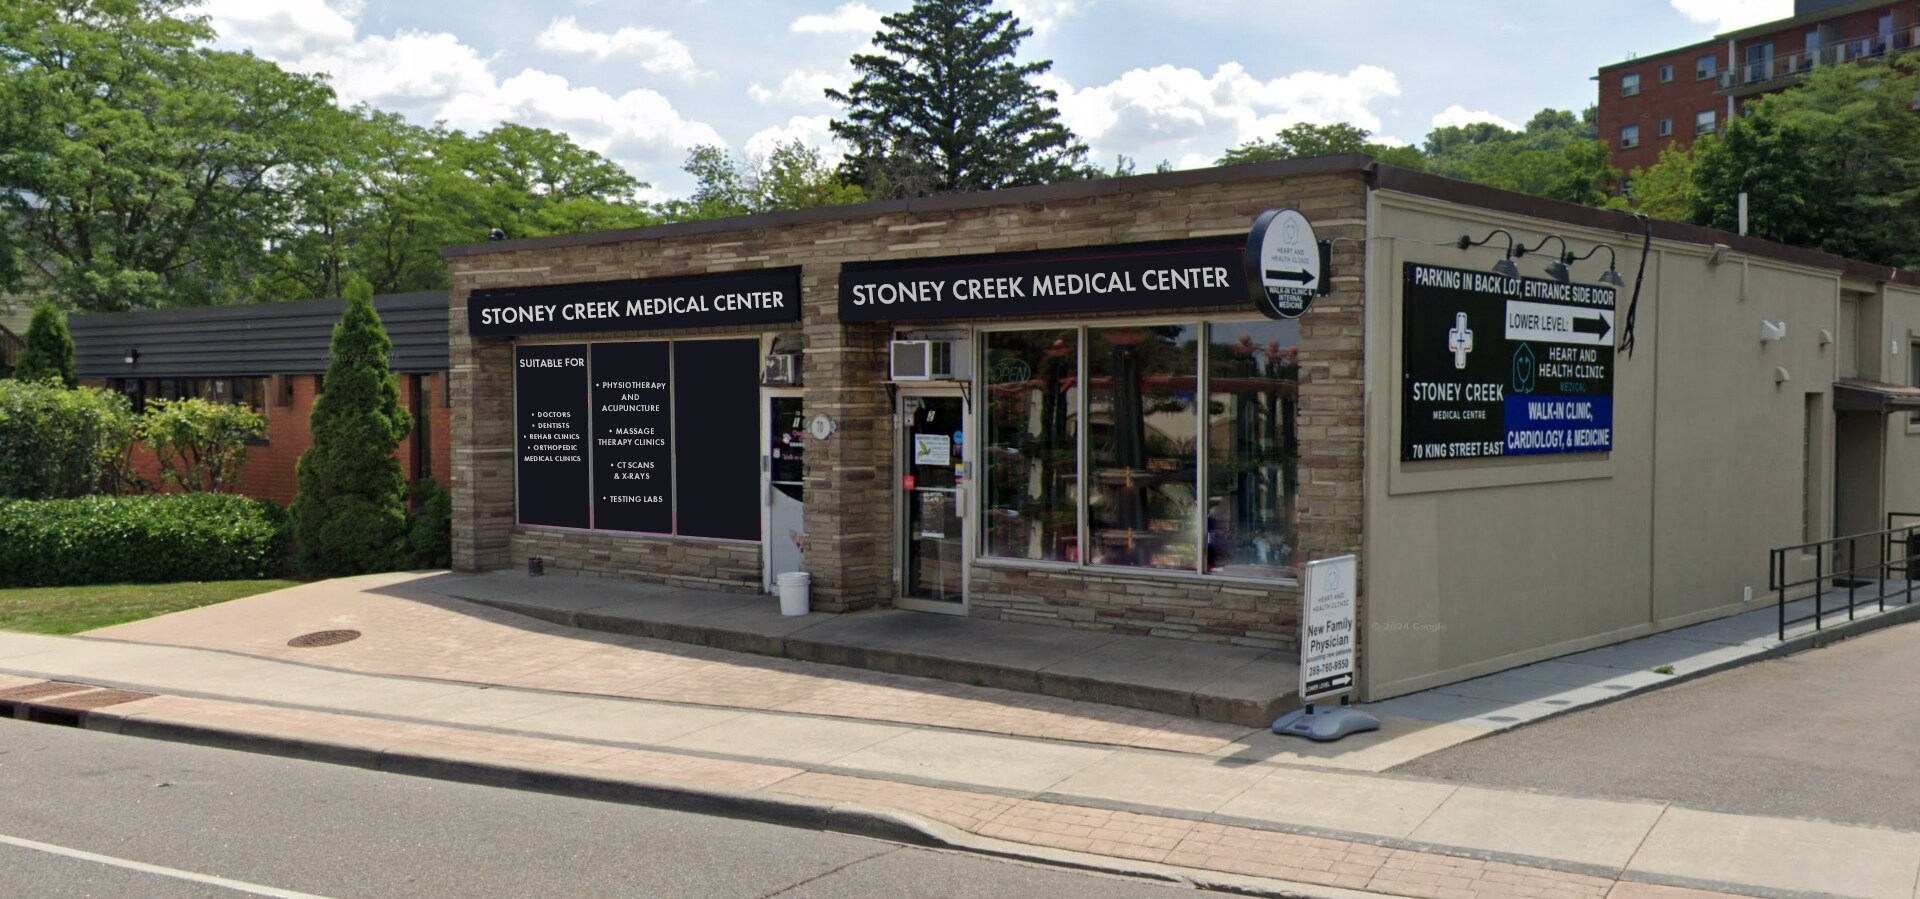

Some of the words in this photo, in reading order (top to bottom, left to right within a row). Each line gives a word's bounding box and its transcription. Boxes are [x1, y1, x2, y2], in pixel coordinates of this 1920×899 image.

[852, 280, 946, 306] STONEY
[953, 276, 1026, 300] CREEK
[1032, 271, 1136, 297] MEDICAL
[1141, 266, 1230, 292] CENTER
[1291, 288, 1308, 296] CLINIC
[1416, 267, 1461, 289] PARKING
[1462, 273, 1472, 290] IN
[1475, 274, 1501, 294] BACK
[1503, 278, 1522, 298] LOT,
[1524, 281, 1571, 302] ENTRANCE
[1572, 286, 1591, 304] SIDE
[1592, 288, 1614, 306] DOOR
[480, 304, 558, 326] STONEY
[562, 300, 622, 321] CREEK
[625, 296, 710, 318] MEDICAL
[713, 290, 785, 312] CENTER
[1509, 313, 1540, 330] LOWER
[1541, 316, 1569, 332] LEVEL:
[519, 358, 563, 368] SUITABLE
[564, 357, 585, 368] FOR
[1549, 348, 1578, 362] HEART
[1579, 349, 1597, 362] AND
[992, 364, 1027, 382] OPEN
[1538, 364, 1573, 378] HEALTH
[1575, 365, 1604, 379] CLINIC
[602, 382, 666, 390] PHYSIOTHERAPY
[1412, 382, 1462, 401] STONEY
[1466, 384, 1504, 401] CREEK
[1560, 382, 1588, 393] MEDICAL
[602, 404, 660, 412] ACUPUNCTURE
[1432, 410, 1460, 420] MEDICAL
[1462, 410, 1486, 420] CENTRE
[1528, 402, 1564, 420] WALK-IN
[1566, 402, 1593, 422] CLINIC,
[816, 420, 824, 432] 70
[1508, 430, 1565, 450] CARDIOLOGY,
[1566, 432, 1572, 446] &
[1574, 429, 1610, 446] MEDICINE
[1413, 444, 1423, 460] 70
[1424, 442, 1448, 458] KING
[1449, 442, 1482, 458] STREET
[1483, 440, 1504, 456] EAST
[628, 461, 654, 469] SCANS
[1318, 594, 1332, 603] HEART
[1312, 602, 1330, 612] HEALTH
[1308, 624, 1324, 638] New
[1326, 617, 1353, 634] Family
[1310, 634, 1349, 653] Physician
